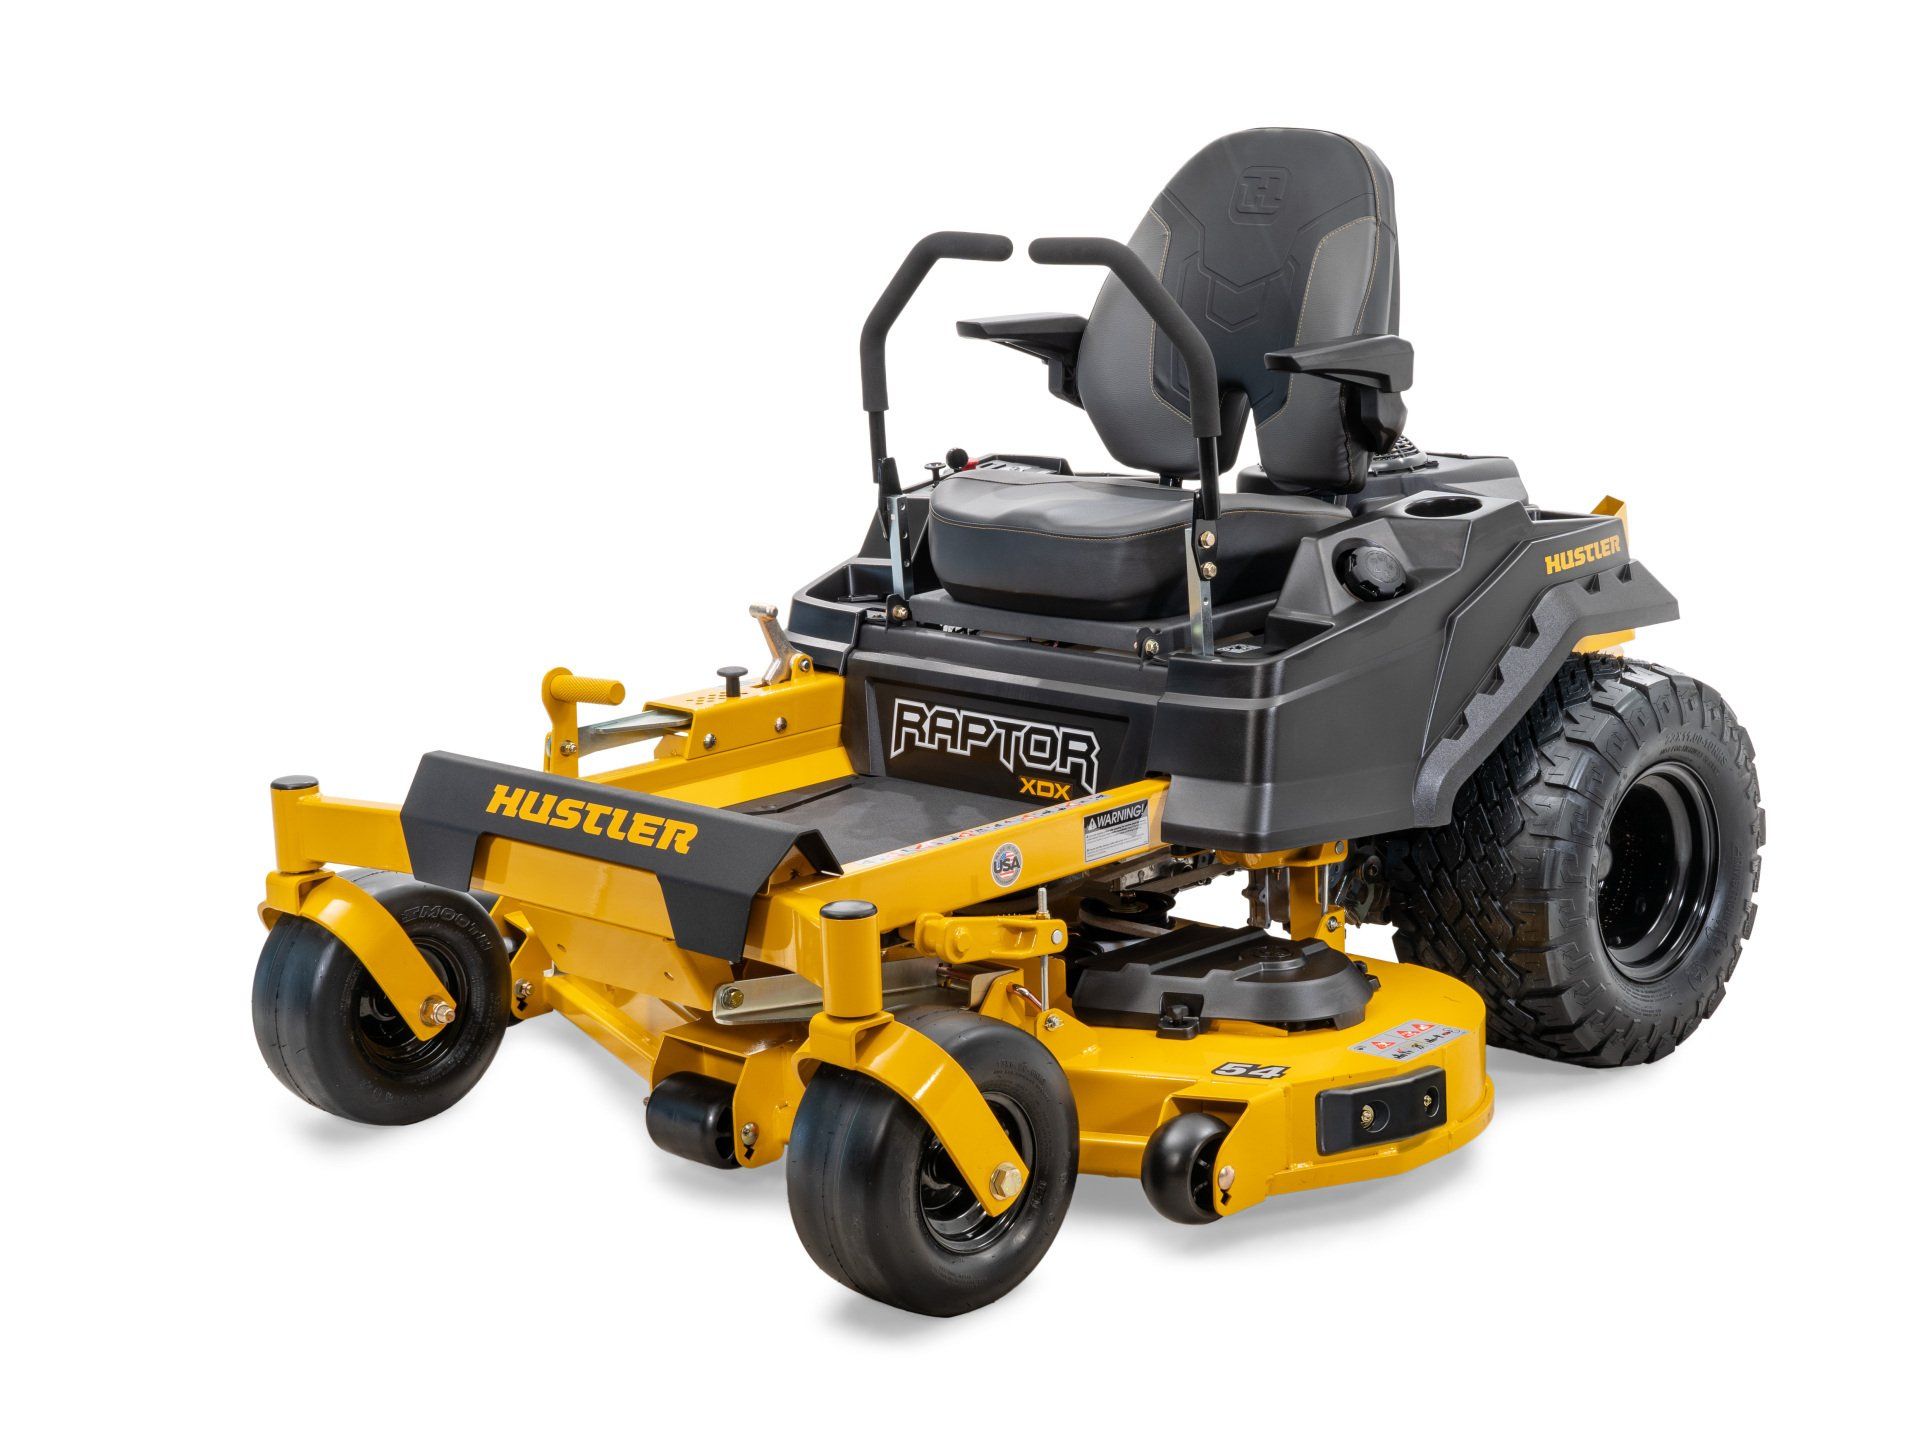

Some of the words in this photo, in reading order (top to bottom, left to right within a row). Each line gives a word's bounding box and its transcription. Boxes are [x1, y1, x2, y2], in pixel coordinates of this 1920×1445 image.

[1545, 534, 1621, 575] HUSTLER
[890, 697, 1101, 796] RAPTOR
[1019, 776, 1073, 801] XDX
[485, 783, 699, 855] HUSTLER
[1096, 803, 1146, 828] WARNING!
[993, 855, 1021, 874] USA
[401, 905, 495, 951] SMOOTH
[1213, 1061, 1288, 1079] 54
